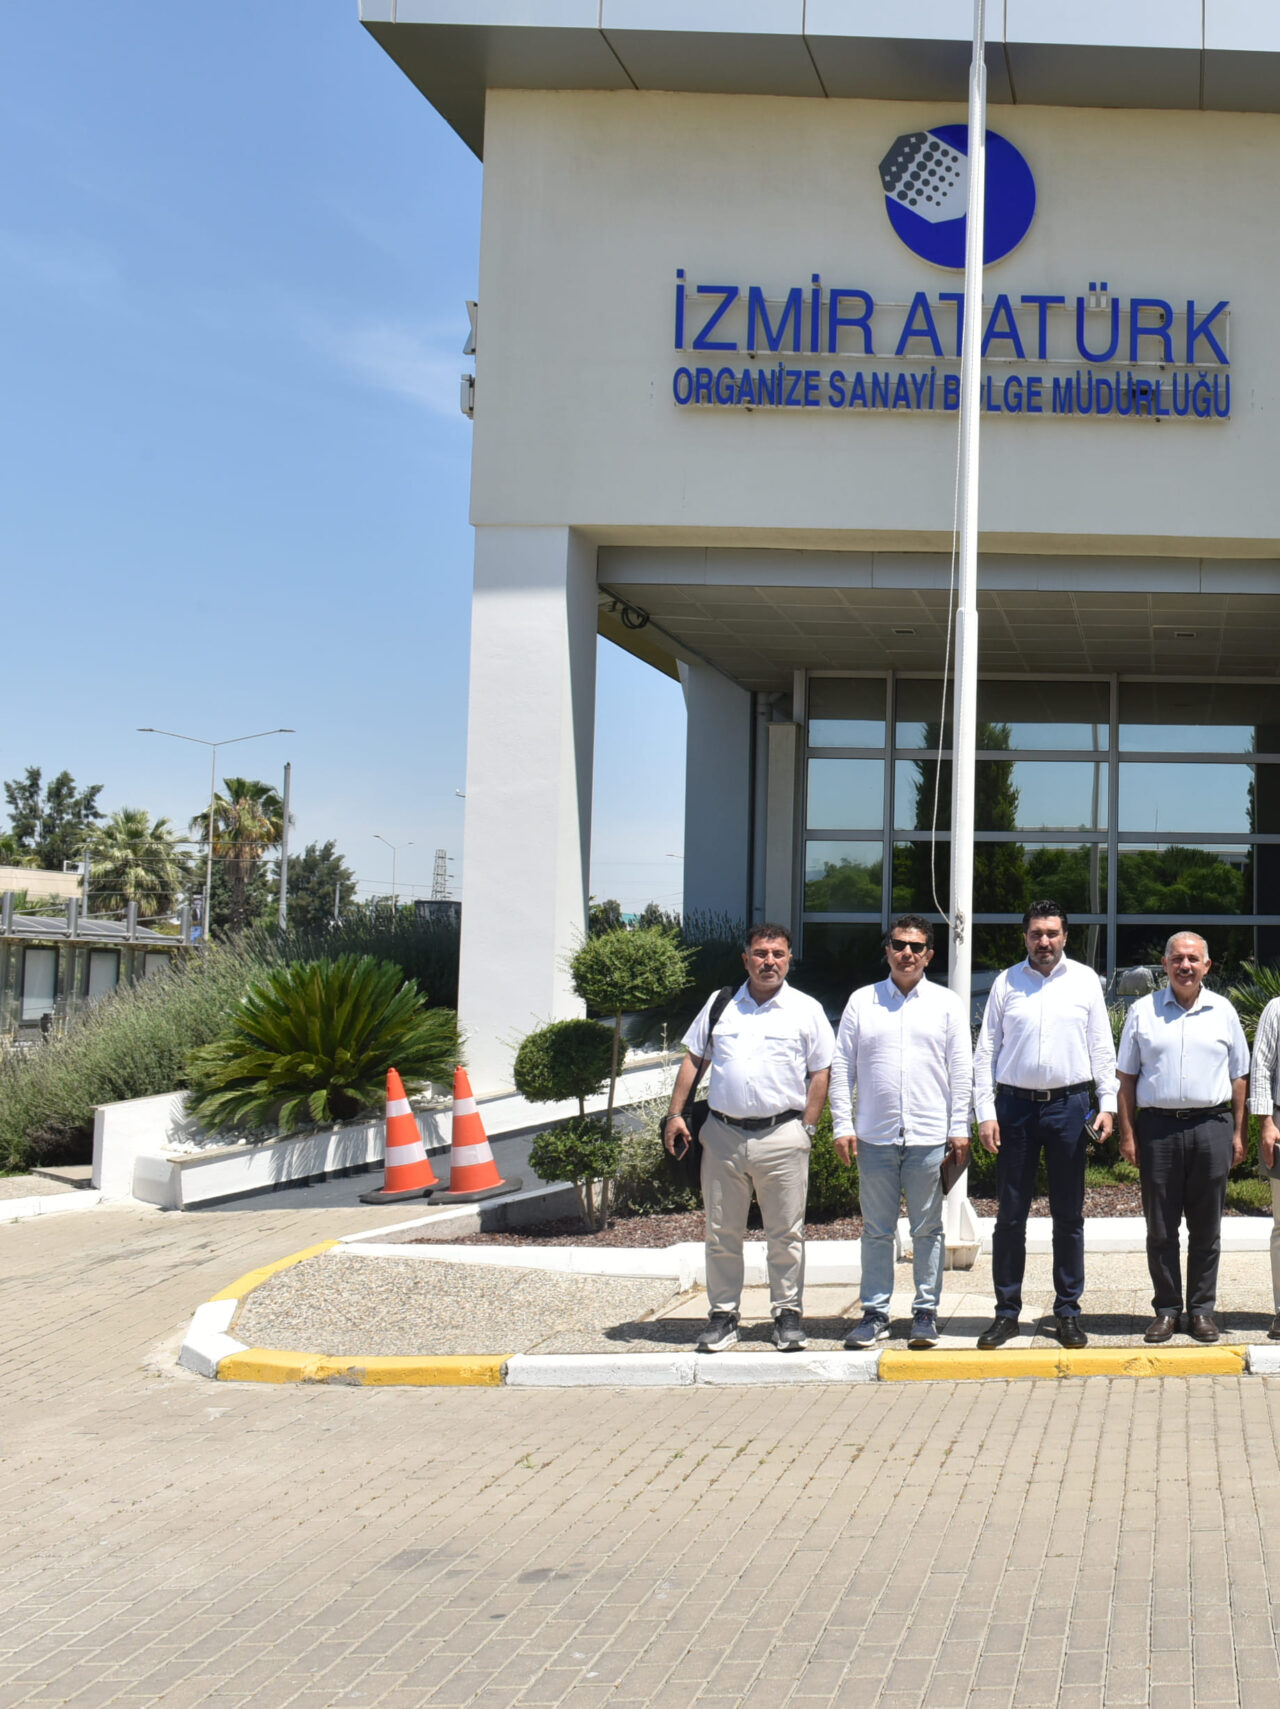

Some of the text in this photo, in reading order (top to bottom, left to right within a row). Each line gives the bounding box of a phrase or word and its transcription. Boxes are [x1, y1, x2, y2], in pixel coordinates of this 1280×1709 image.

[675, 269, 1230, 365] İZMİR ATATÜRK
[673, 361, 1231, 418] ORGANİZE SANAYİ BLGE MÜDÜRLÜĞÜ
